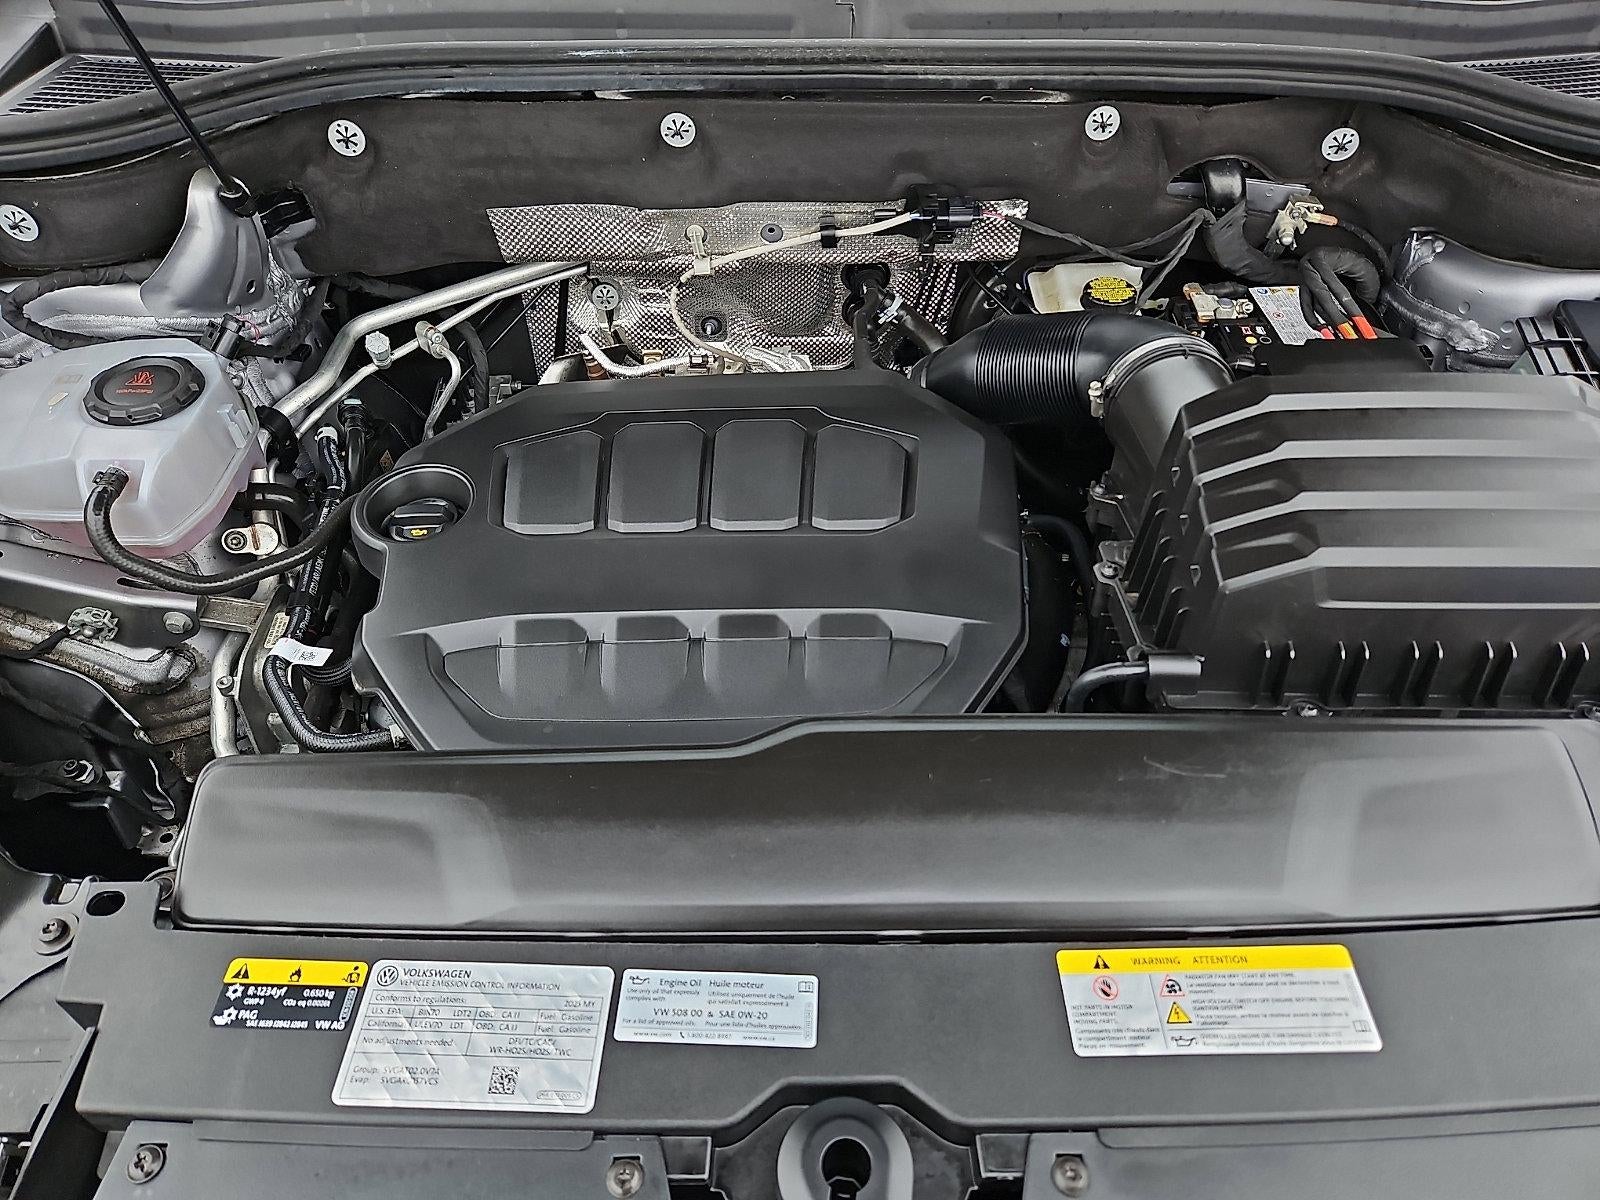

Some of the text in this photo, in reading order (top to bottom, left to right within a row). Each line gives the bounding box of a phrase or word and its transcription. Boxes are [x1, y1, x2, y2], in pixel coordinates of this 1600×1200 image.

[1130, 956, 1180, 965] WARNING
[1192, 955, 1248, 964] ATTENTION
[403, 968, 472, 979] VOLKSWAGEN
[432, 980, 469, 988] EMISSION
[470, 981, 504, 989] CONTROL
[507, 982, 560, 991] INFORMATION
[660, 979, 702, 988] Engine Oil
[709, 979, 764, 989] Huile moteur
[247, 986, 288, 1000] R-1234yf
[303, 988, 335, 1000] 0.650 kg
[376, 993, 412, 1002] Conforms
[413, 995, 421, 1003] to
[238, 1009, 258, 1020] PAG
[453, 1009, 472, 1017] LDT2
[502, 1011, 513, 1019] CA
[561, 1013, 594, 1021] Gasoline
[653, 1008, 669, 1016] VW
[672, 1009, 688, 1017] 508
[690, 1009, 703, 1017] 00
[719, 1010, 735, 1019] SAE
[737, 1011, 768, 1020] 0W-20
[314, 1020, 346, 1031] VW AG
[450, 1022, 464, 1030] LDT
[499, 1023, 511, 1031] CA
[559, 1026, 592, 1034] Gasoline
[375, 1036, 423, 1047] adjustments
